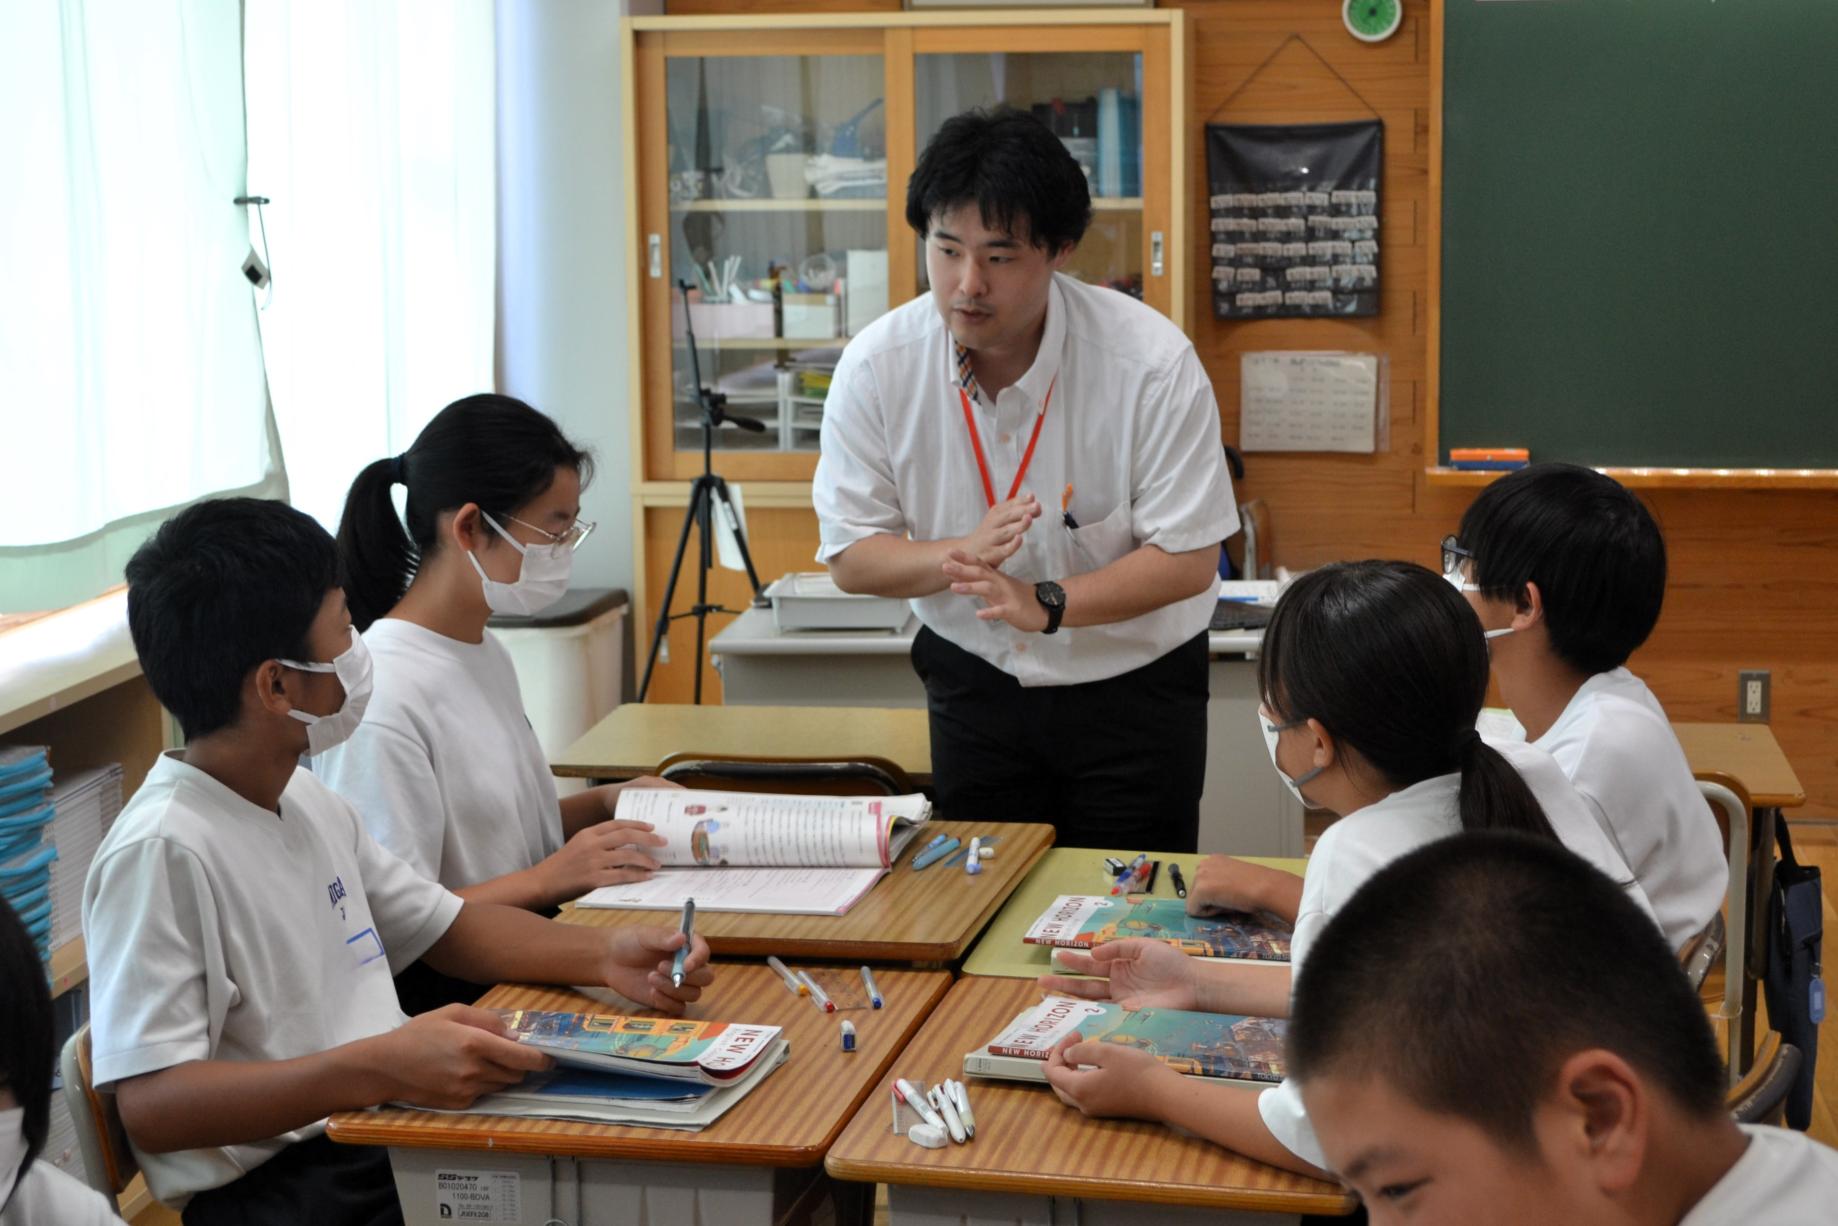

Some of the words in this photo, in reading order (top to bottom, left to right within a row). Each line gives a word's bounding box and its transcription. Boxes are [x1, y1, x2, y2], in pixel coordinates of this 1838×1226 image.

[1033, 1000, 1077, 1033] HORIZON
[725, 1029, 763, 1054] NEW
[1002, 1047, 1020, 1056] NEW
[1023, 1050, 1050, 1059] HORIZ
